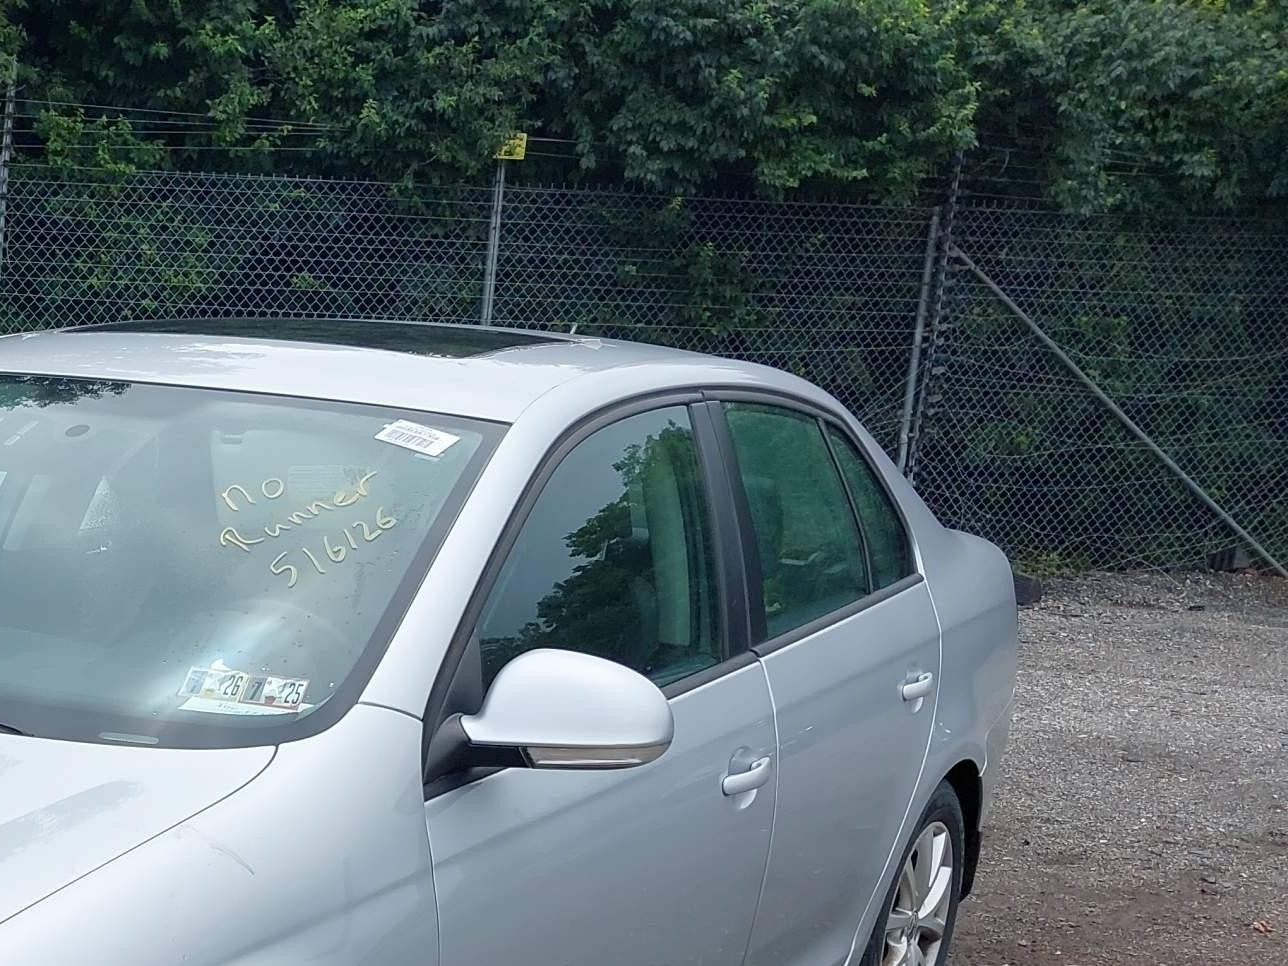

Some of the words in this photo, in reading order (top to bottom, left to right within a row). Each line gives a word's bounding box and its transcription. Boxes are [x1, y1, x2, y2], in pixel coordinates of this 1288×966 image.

[220, 471, 377, 551] Runner
[223, 674, 244, 696] 26
[284, 682, 304, 704] 25
